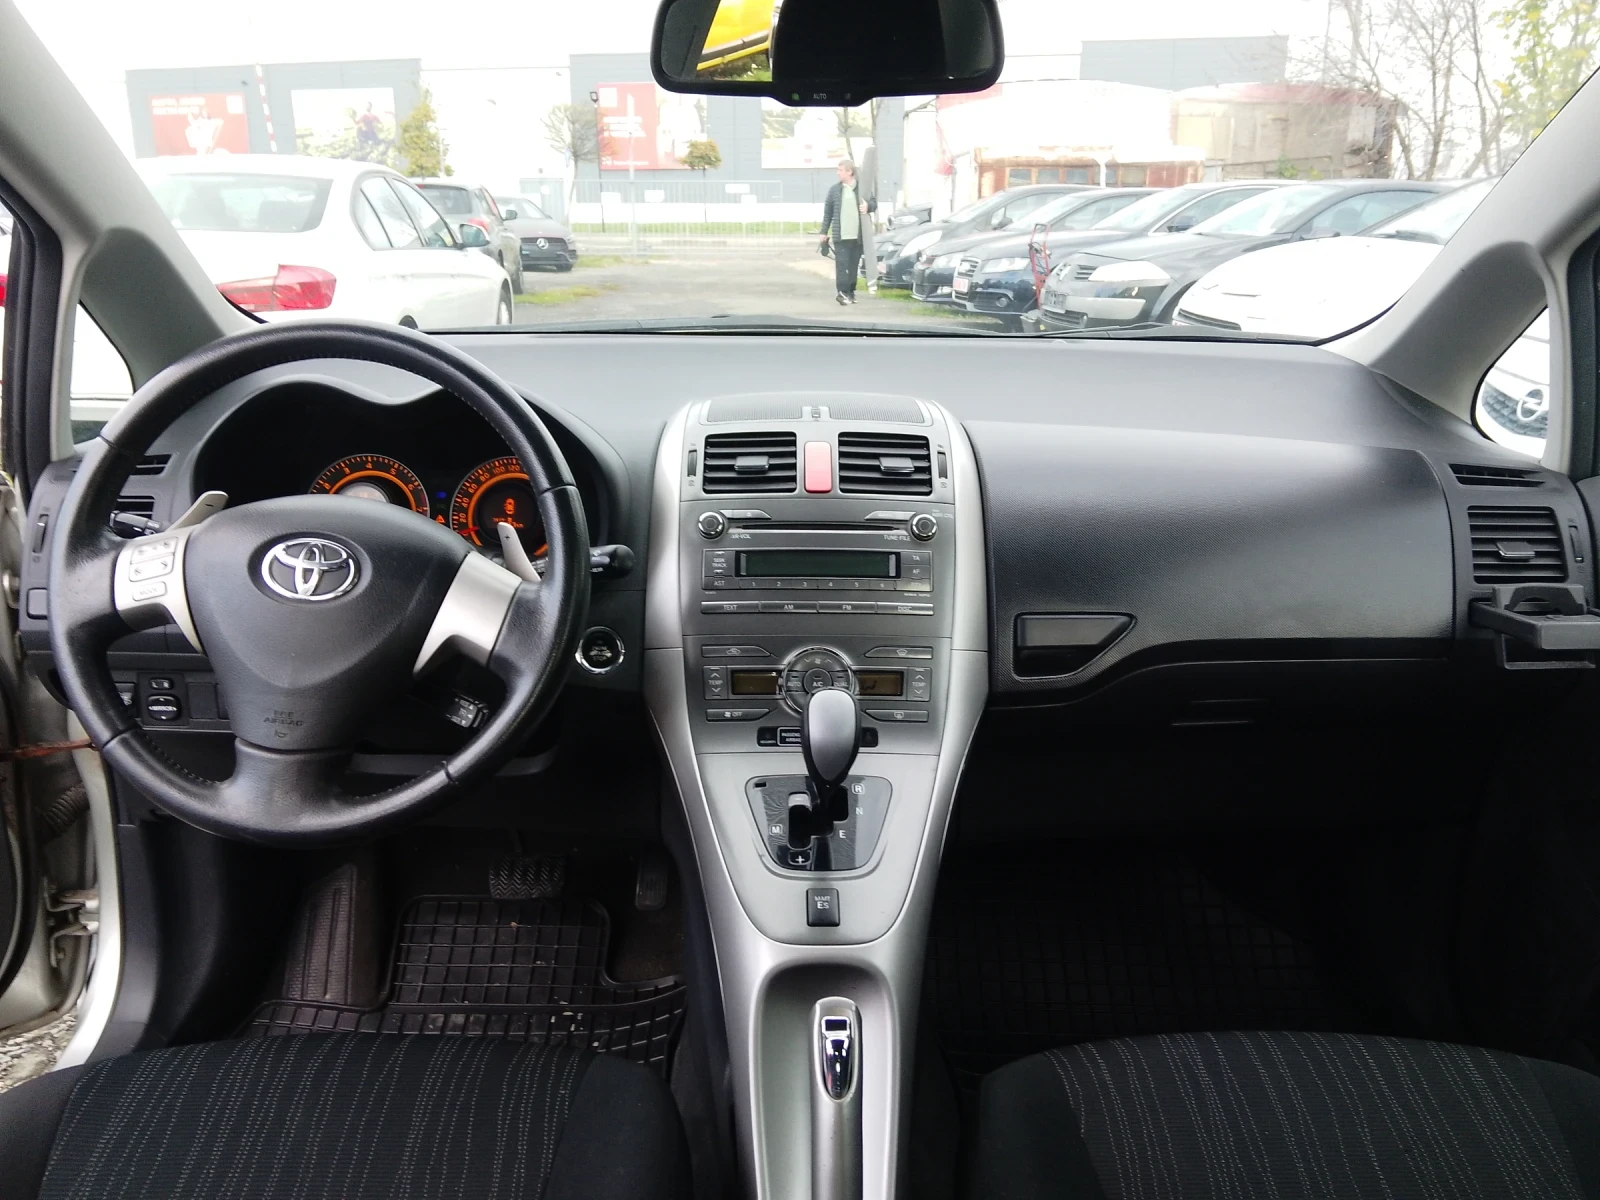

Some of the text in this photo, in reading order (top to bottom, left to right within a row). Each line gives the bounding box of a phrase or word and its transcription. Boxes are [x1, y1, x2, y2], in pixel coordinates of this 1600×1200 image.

[493, 466, 505, 474] 100
[468, 483, 478, 493] 60
[461, 498, 469, 508] 40
[460, 513, 466, 522] 20
[263, 716, 303, 727] AIRBAG
[839, 830, 846, 838] E
